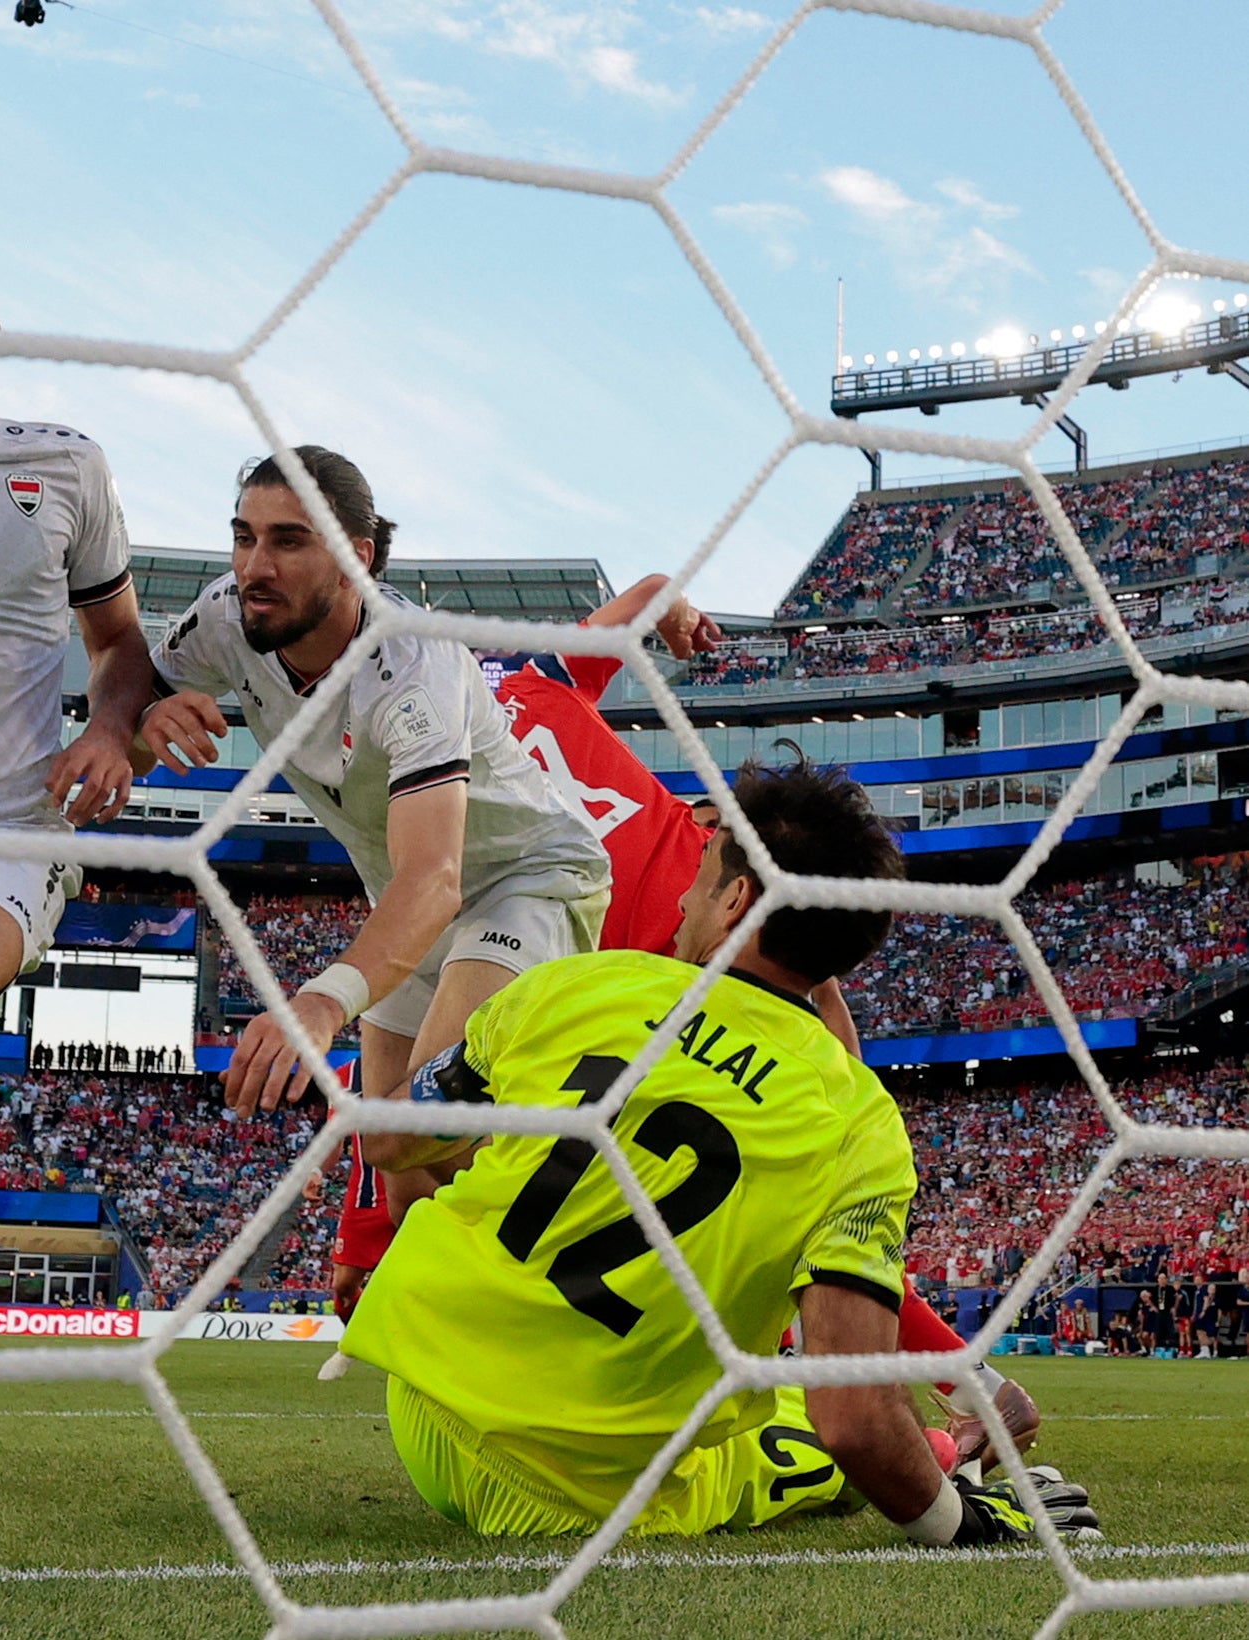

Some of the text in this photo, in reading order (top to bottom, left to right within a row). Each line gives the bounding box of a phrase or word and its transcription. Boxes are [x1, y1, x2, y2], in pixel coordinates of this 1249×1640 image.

[482, 662, 503, 671] FIFA
[407, 718, 431, 734] PEACE
[479, 931, 521, 951] JAKO
[497, 1055, 742, 1338] 12
[202, 1314, 274, 1340] Dove
